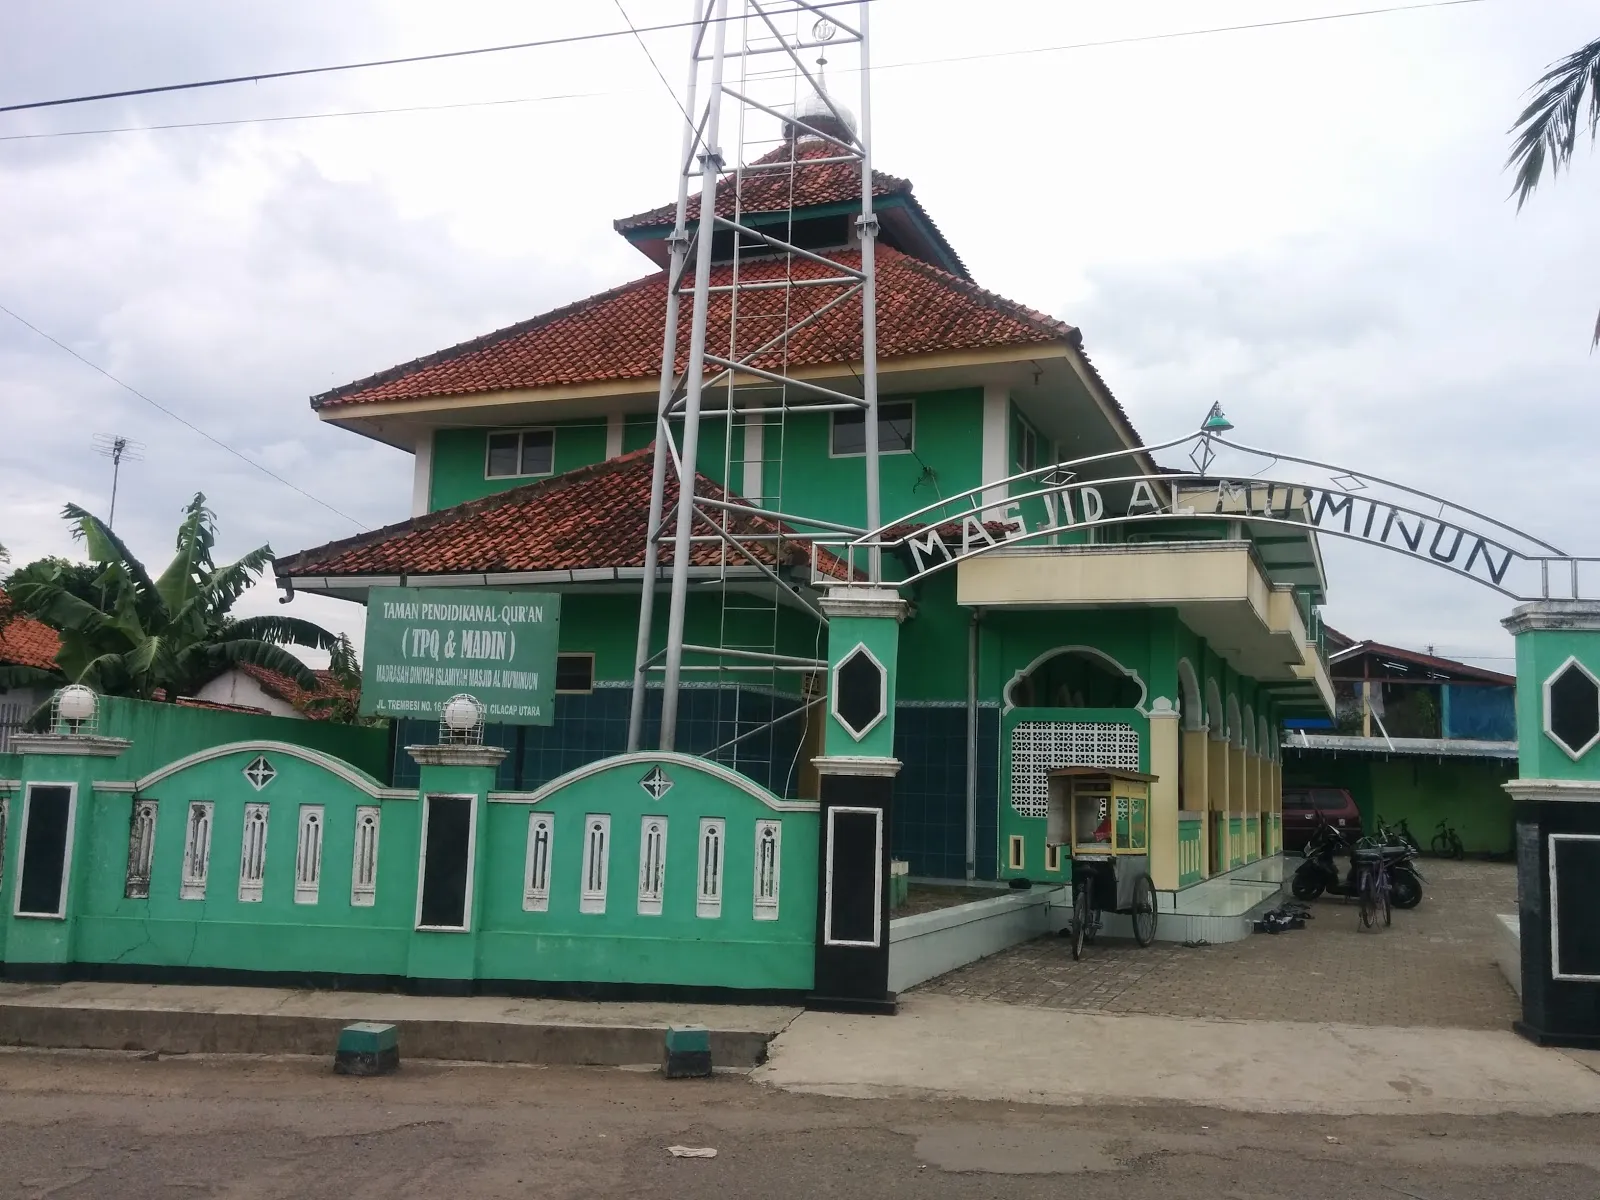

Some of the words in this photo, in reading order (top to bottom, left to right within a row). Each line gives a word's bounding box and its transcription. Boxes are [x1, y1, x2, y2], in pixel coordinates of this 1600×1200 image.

[907, 487, 1104, 573] MASJID
[1127, 479, 1196, 516] AL
[383, 602, 419, 620] TAMAN
[421, 603, 484, 622] PENDIDIKAN
[444, 630, 456, 659] &
[376, 665, 409, 684] MADRASAH
[410, 666, 434, 685] DINIYAH
[435, 667, 468, 686] ISLAMIYAH
[468, 668, 492, 688] MASJID
[493, 670, 501, 688] AL
[376, 699, 387, 710] JL.
[388, 699, 420, 711] TREMBESI
[420, 700, 432, 711] NO.
[490, 704, 517, 716] CILACAP
[518, 705, 540, 717] UTARA
